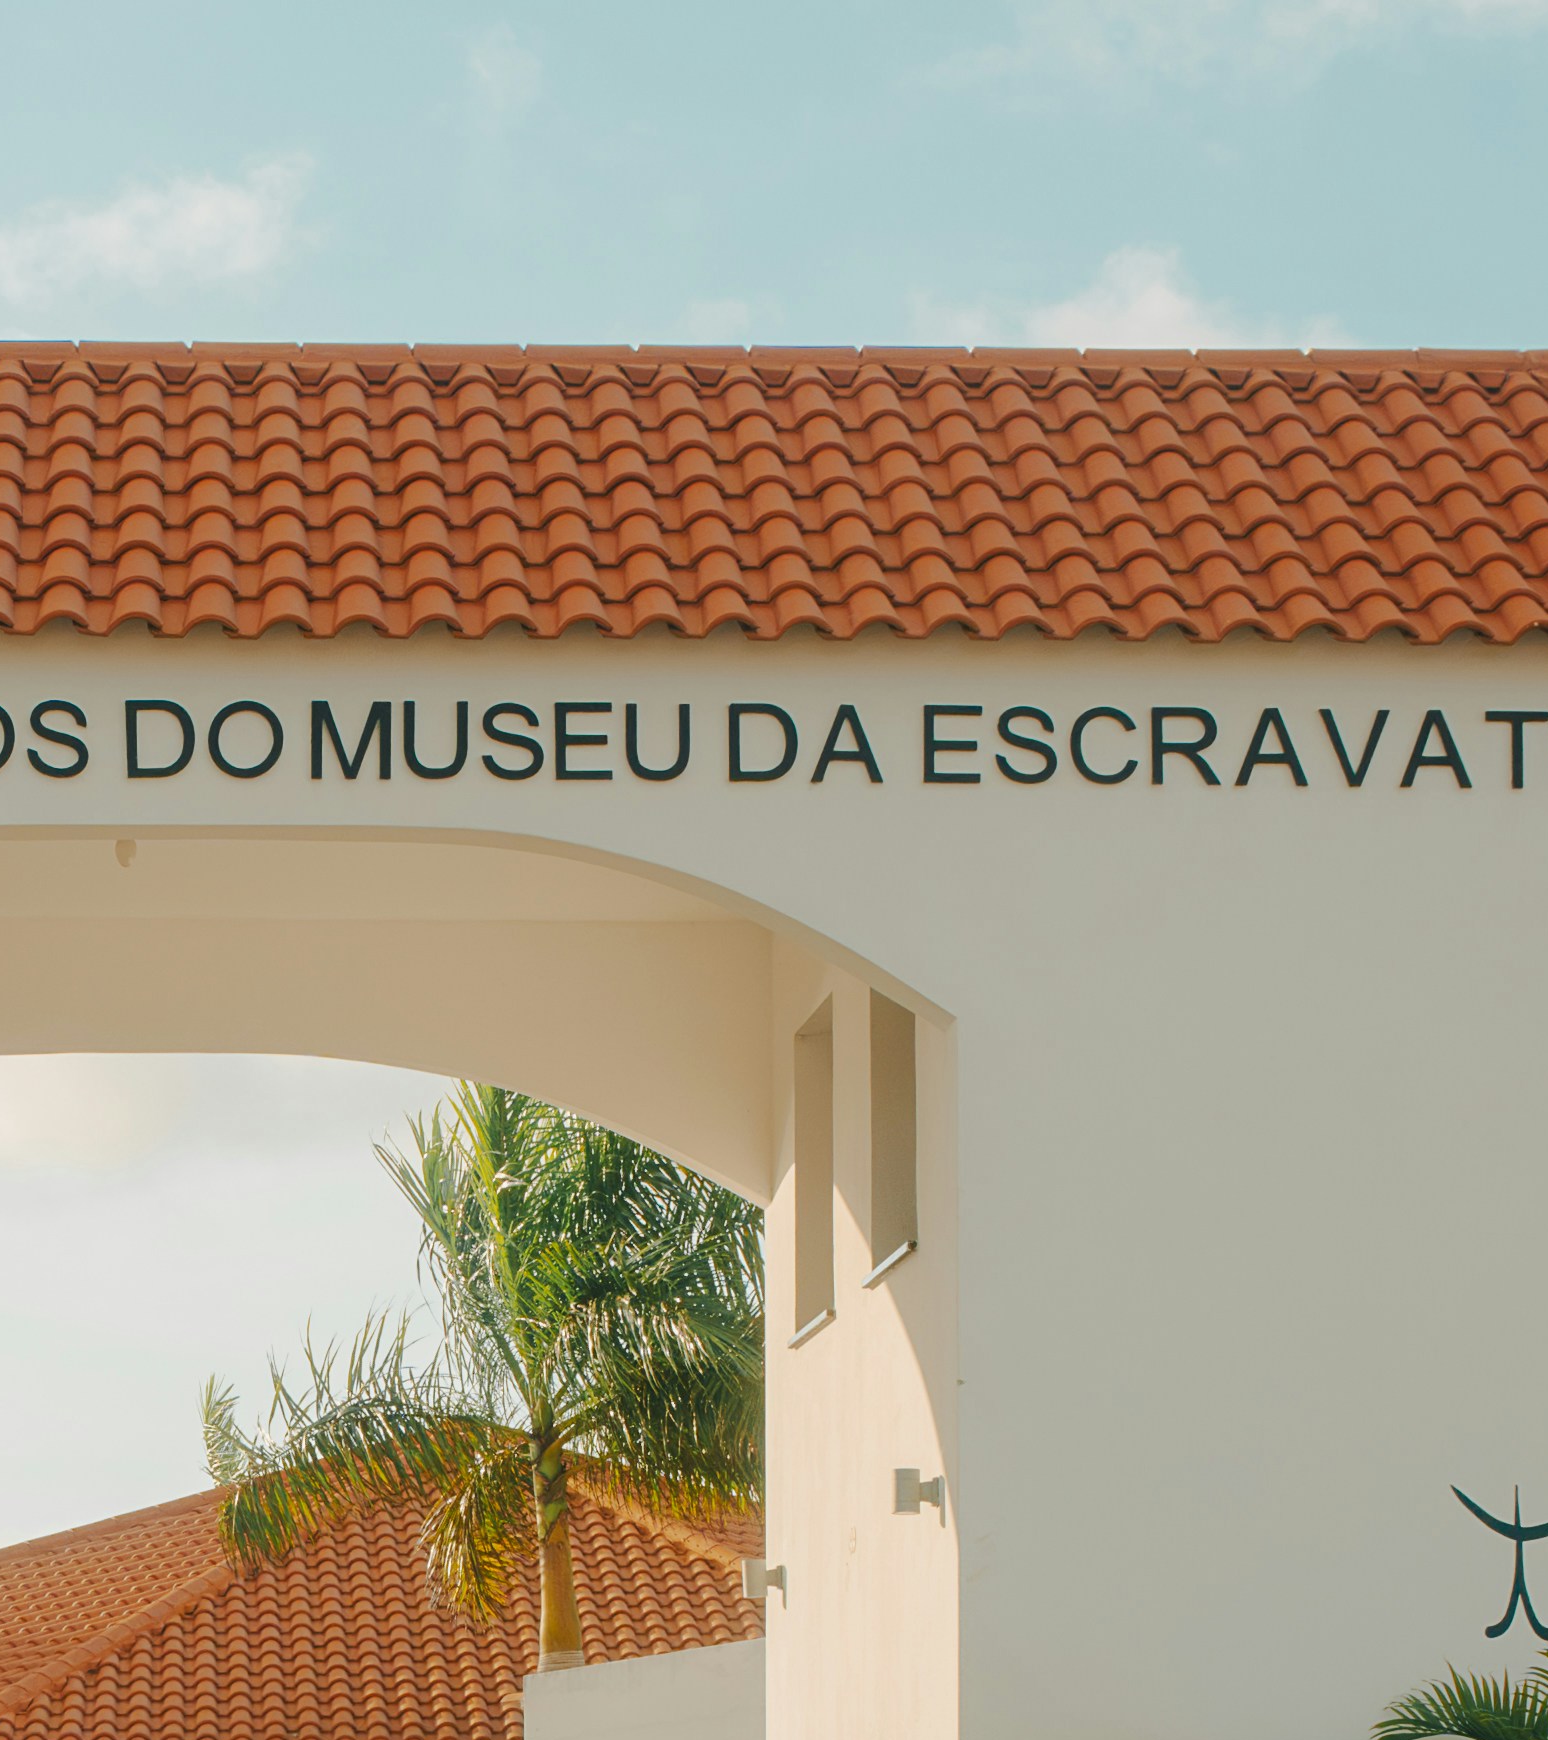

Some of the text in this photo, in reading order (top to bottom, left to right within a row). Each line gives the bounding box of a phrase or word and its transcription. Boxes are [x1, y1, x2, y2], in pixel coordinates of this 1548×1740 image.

[123, 699, 285, 780] DO
[309, 700, 692, 783] MUSEU
[727, 702, 885, 785] DA
